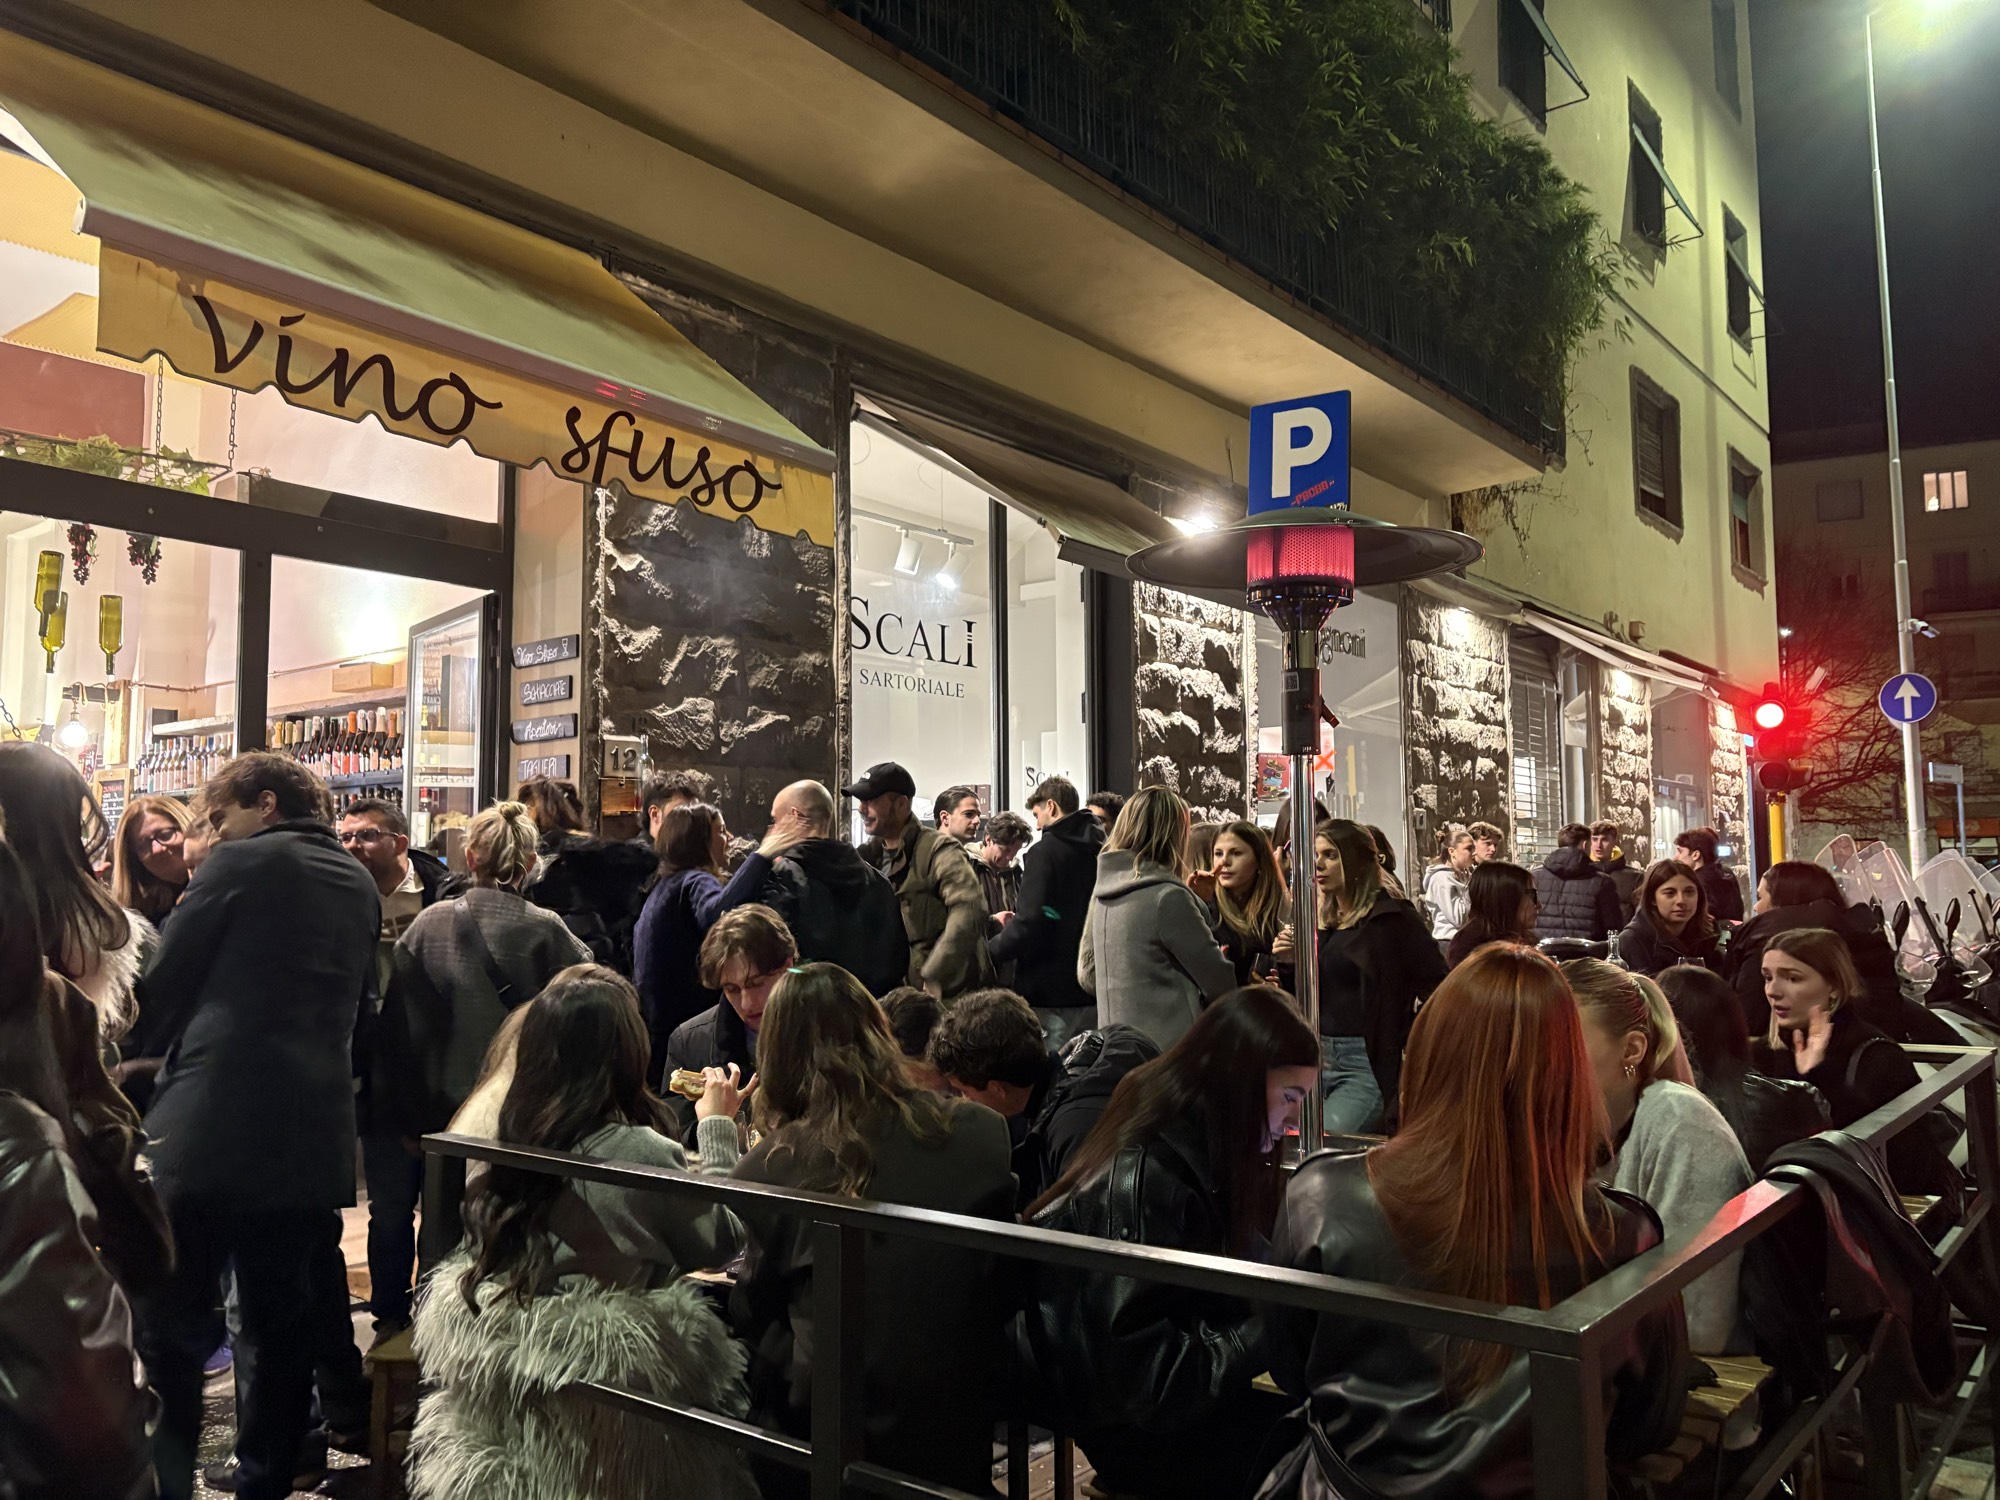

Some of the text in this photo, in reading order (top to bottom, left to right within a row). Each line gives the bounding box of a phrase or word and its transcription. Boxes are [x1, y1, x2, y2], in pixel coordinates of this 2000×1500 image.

[1271, 406, 1333, 499] P
[851, 596, 978, 668] SCALI
[860, 668, 965, 698] SARTORIALE
[610, 745, 638, 771] 12
